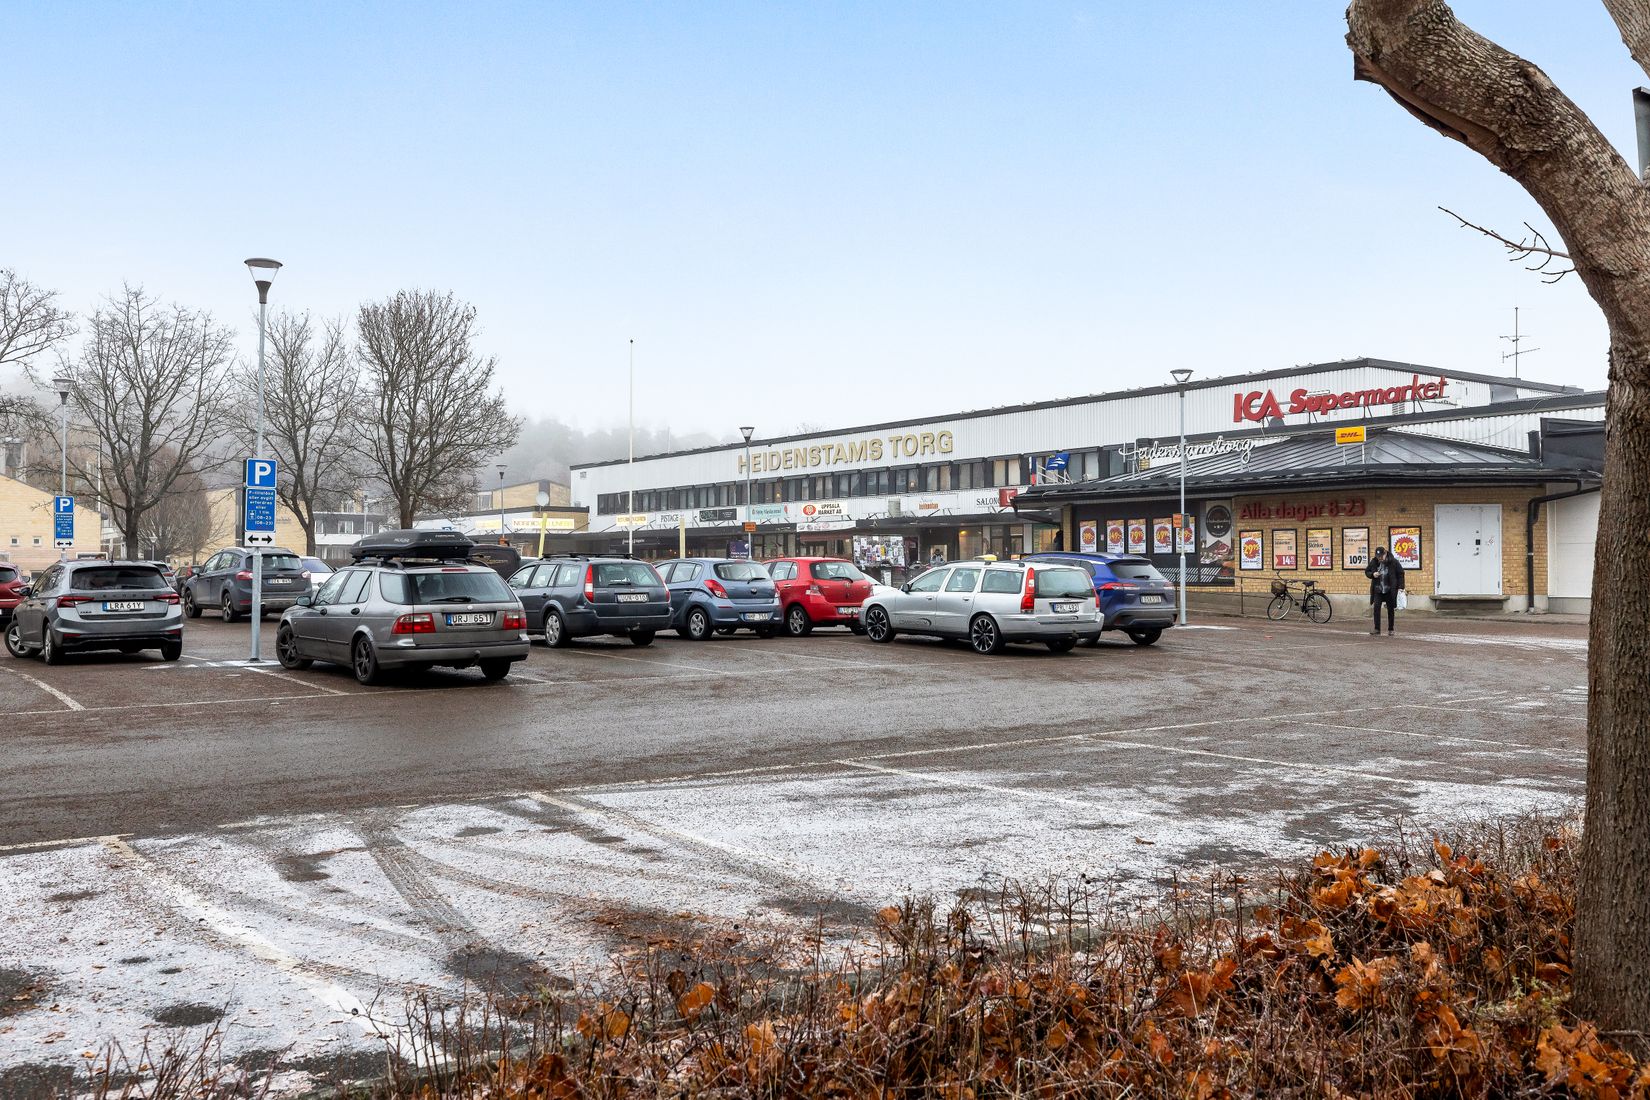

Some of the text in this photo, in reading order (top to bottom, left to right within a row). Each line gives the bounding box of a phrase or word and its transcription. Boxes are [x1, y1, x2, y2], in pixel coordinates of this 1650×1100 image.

[1233, 375, 1449, 423] ICA Supermarket
[737, 430, 954, 474] HEIDENSTAMS TORG
[255, 462, 271, 485] P
[60, 498, 71, 512] P
[1240, 501, 1271, 519] Alla
[1276, 501, 1325, 522] dagar
